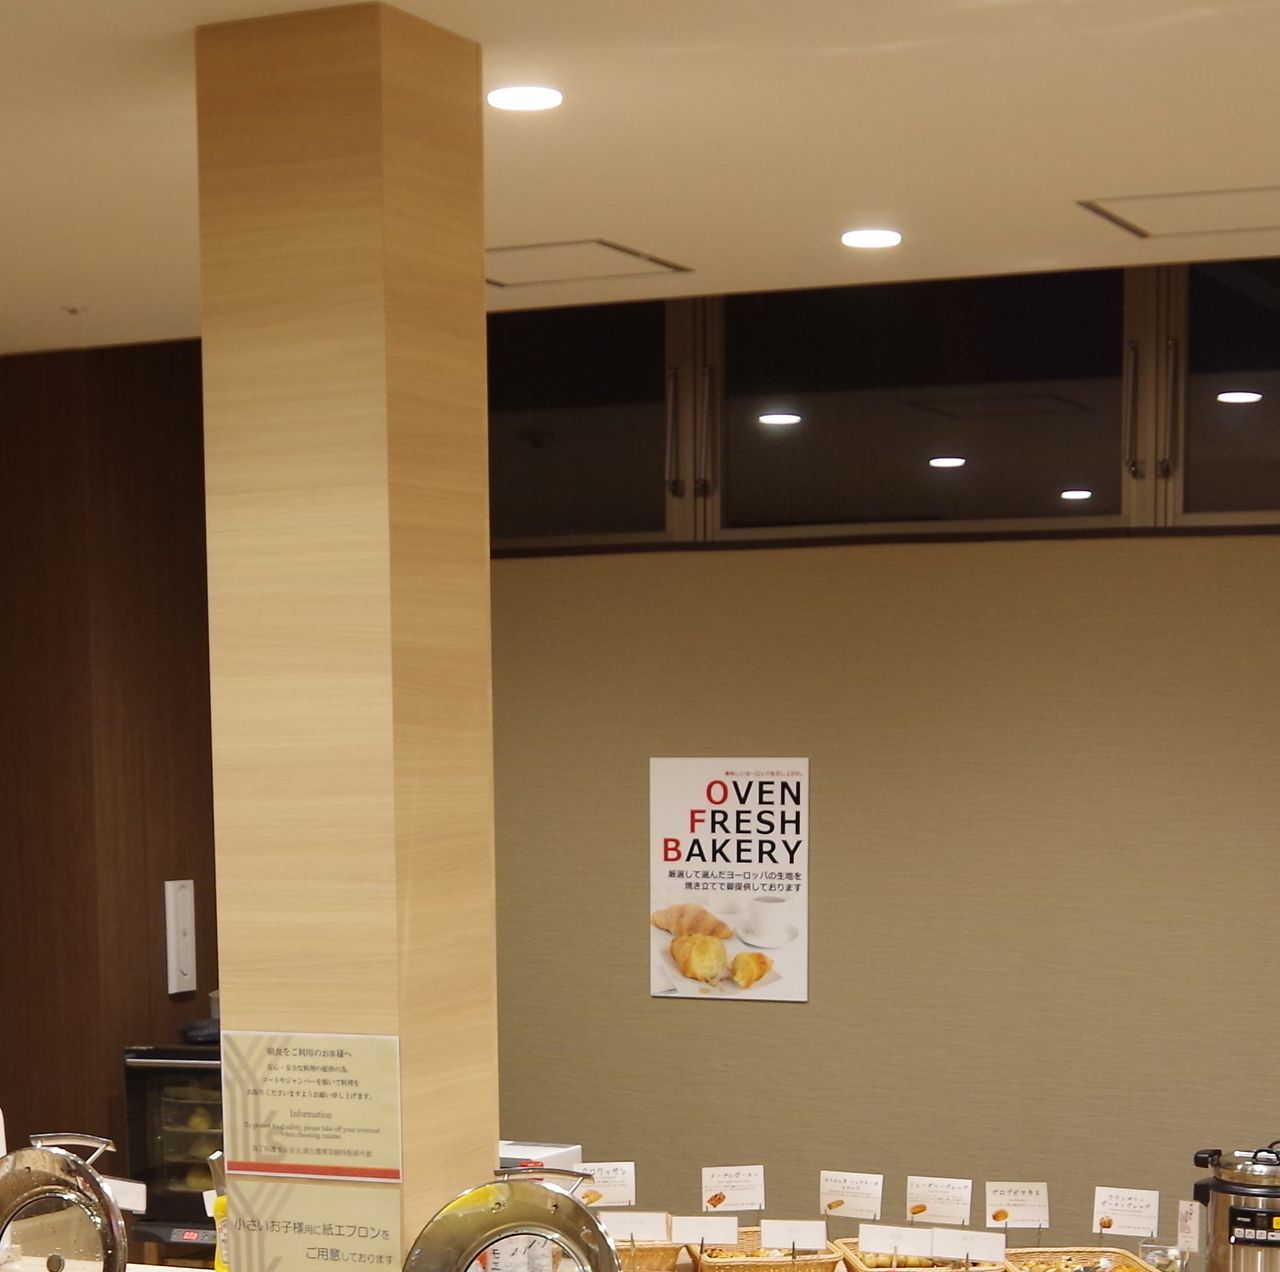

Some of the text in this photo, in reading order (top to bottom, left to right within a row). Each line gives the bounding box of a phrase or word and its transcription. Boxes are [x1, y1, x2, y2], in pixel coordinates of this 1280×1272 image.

[706, 780, 801, 805] OVEN
[689, 809, 801, 834] FRESH
[663, 838, 802, 864] BAKERY
[668, 870, 802, 881] 厳選して選んだヨーロッパの生地を
[290, 1109, 332, 1119] Information
[234, 1217, 390, 1240] 小さいお子様用に紙エプロンを
[306, 1246, 393, 1265] ご用意しております
